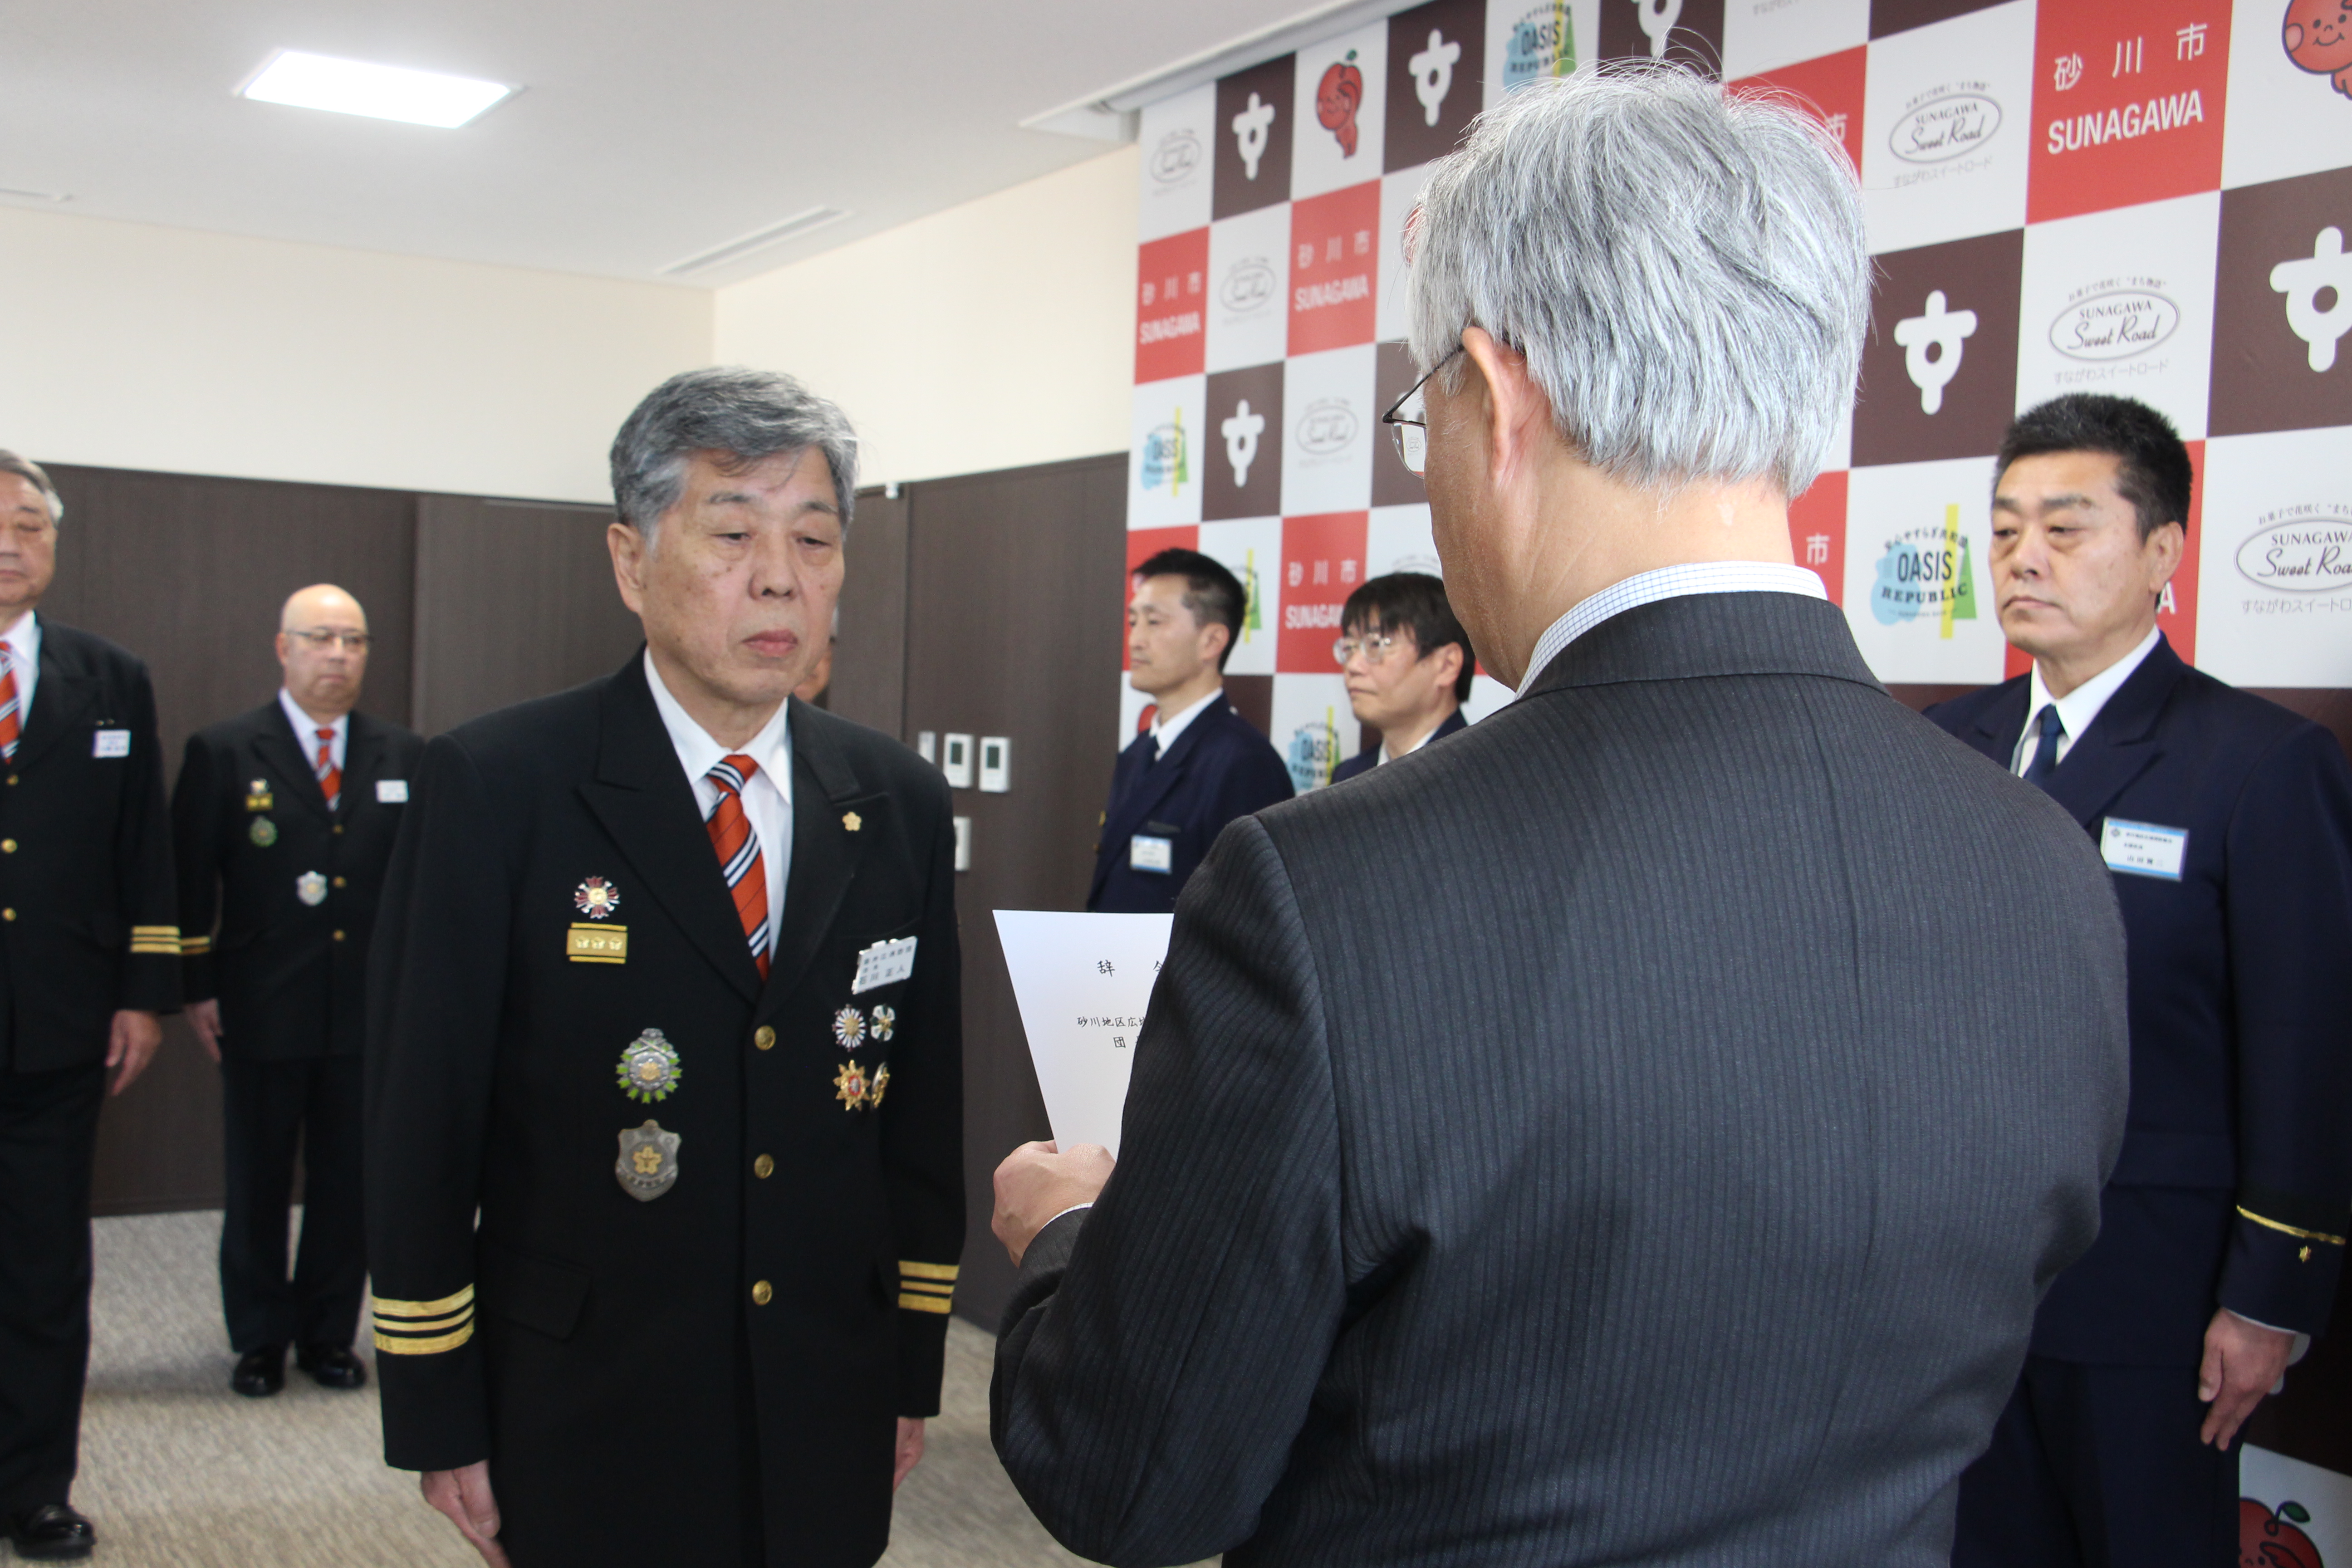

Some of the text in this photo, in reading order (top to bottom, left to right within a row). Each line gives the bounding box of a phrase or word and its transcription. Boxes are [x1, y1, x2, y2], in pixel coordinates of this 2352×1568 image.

[2054, 23, 2207, 91] 砂川市
[1916, 102, 1977, 124] SUNAGAWA
[1947, 113, 1985, 145] Road
[2048, 90, 2203, 154] SUNAGAWA
[1294, 274, 1370, 312] SUNAGAWA
[2080, 300, 2151, 319] SUNAGAWA
[1140, 310, 1200, 345] SUNAGAWA
[2067, 314, 2160, 349] Sweet Road
[1897, 551, 1953, 583] OASIS
[2257, 545, 2352, 577] Sweet Roa
[1882, 583, 1967, 603] REPUBLIC
